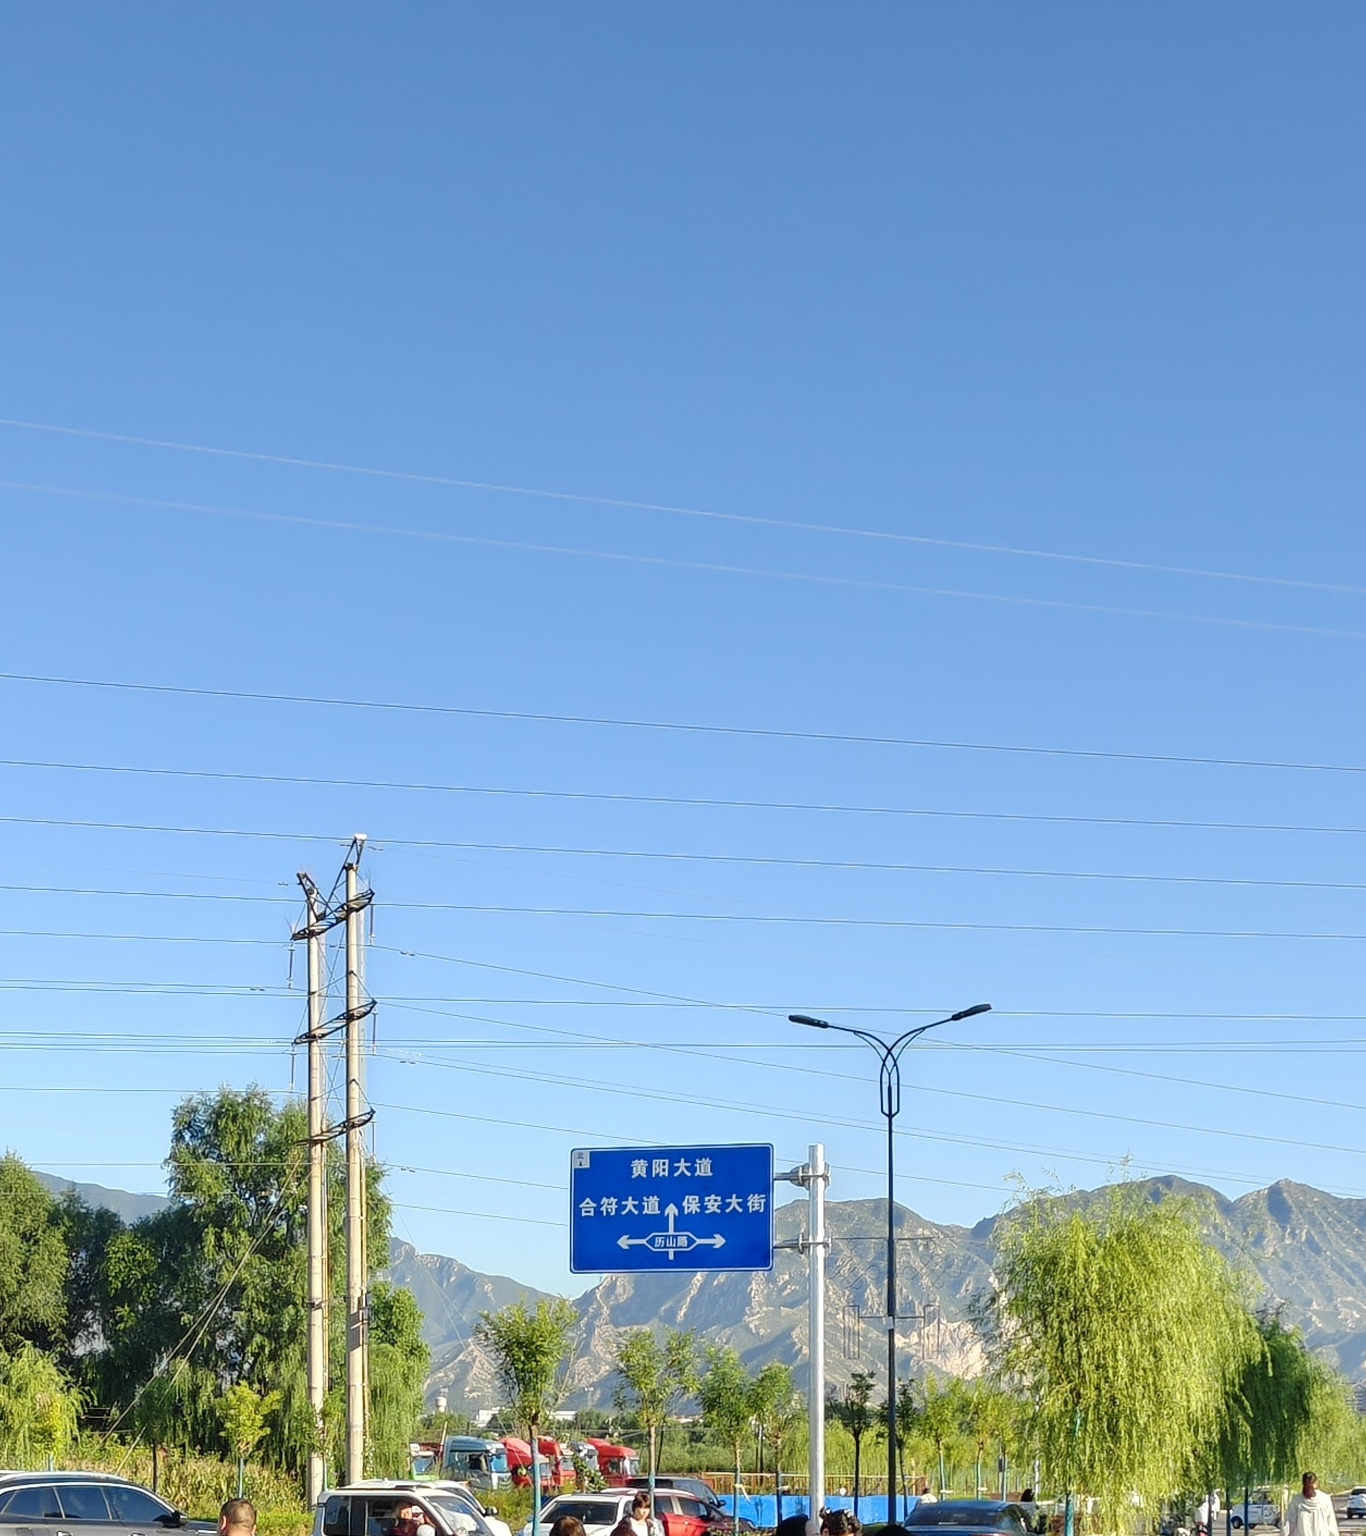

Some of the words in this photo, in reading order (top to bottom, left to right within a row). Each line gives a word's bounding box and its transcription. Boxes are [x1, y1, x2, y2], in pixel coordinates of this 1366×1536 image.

[631, 1158, 714, 1178] 黄阳大道
[579, 1195, 661, 1217] 合符大道
[682, 1193, 767, 1214] 保安大街
